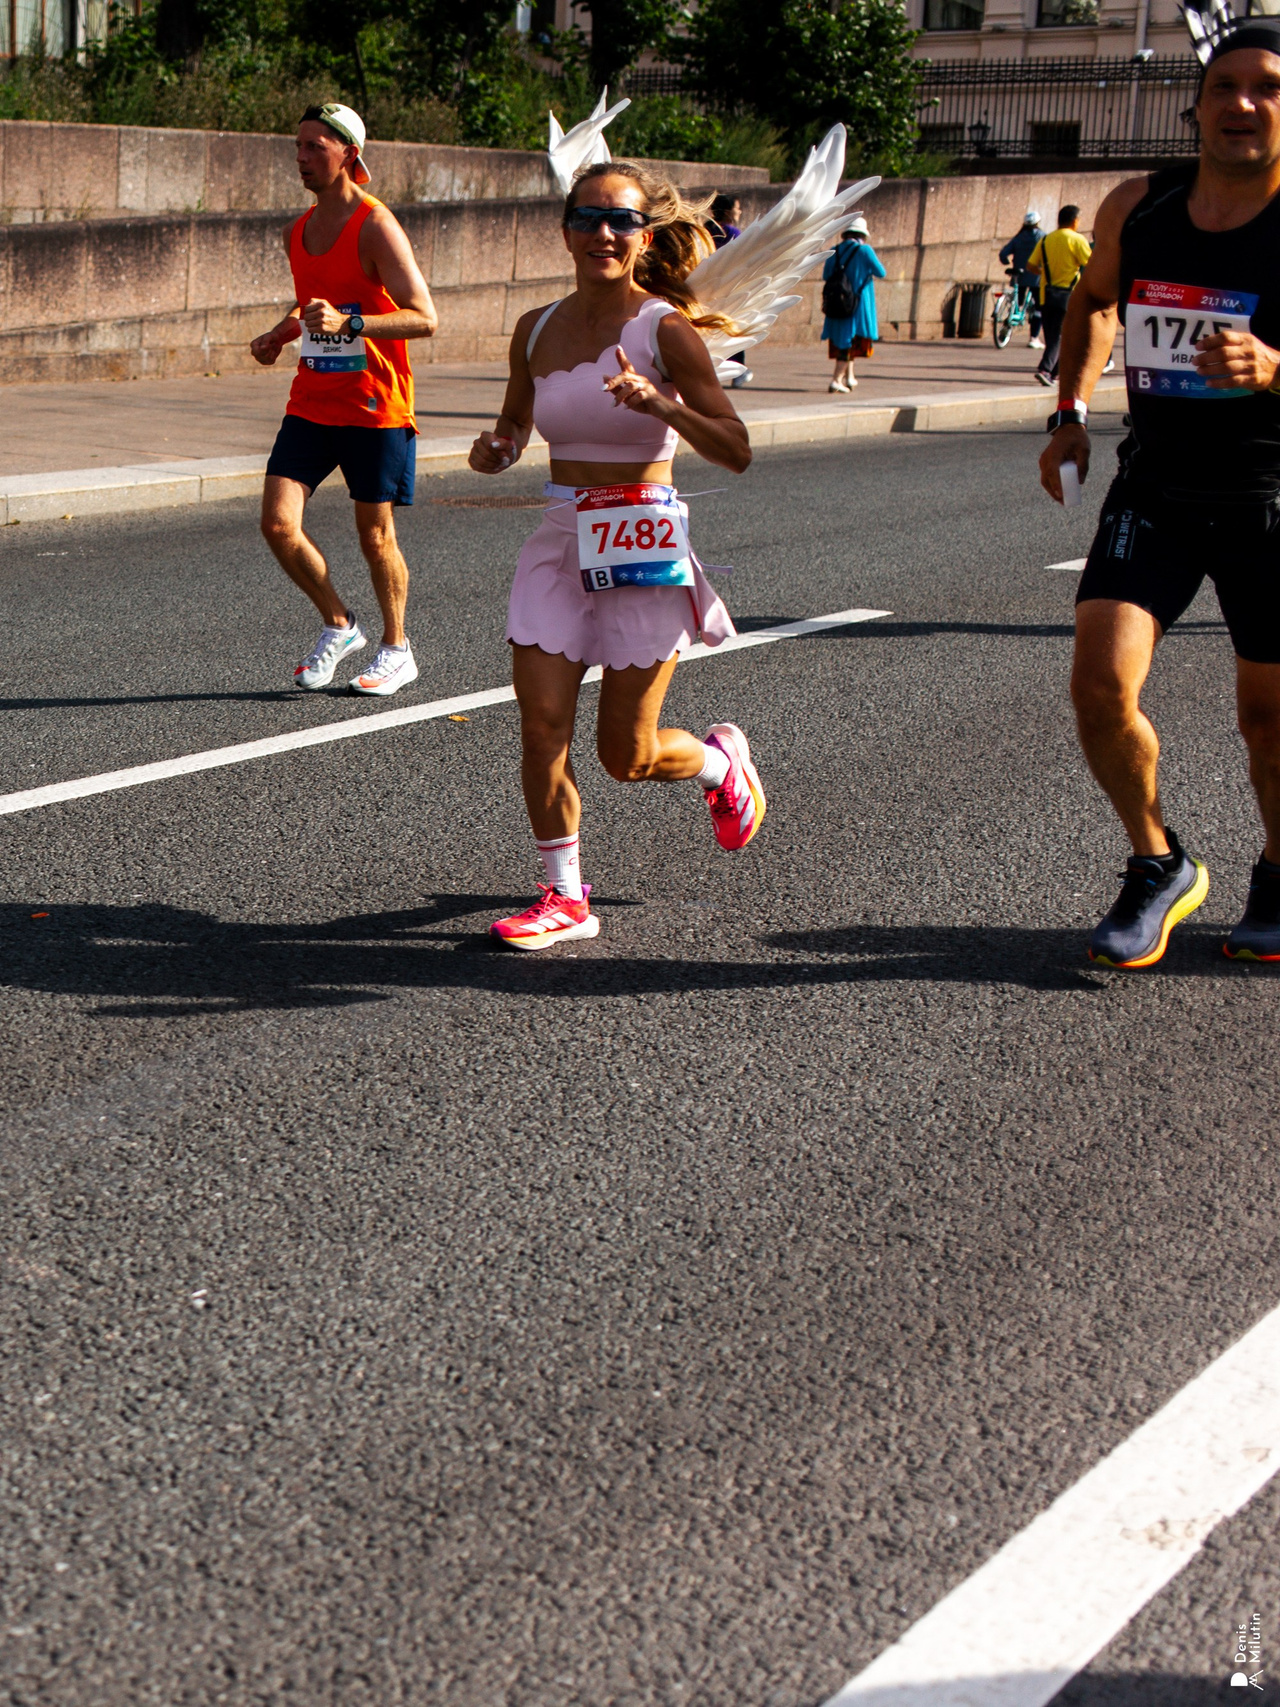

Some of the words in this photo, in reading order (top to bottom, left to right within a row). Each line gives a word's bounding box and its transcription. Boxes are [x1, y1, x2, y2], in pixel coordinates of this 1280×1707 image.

[1147, 284, 1168, 292] ПОЛУ
[1146, 291, 1183, 300] МАРАФОН
[1201, 296, 1219, 306] 21,1
[590, 493, 625, 503] МАРАФОН
[591, 518, 677, 555] 7482
[1114, 535, 1128, 559] TRUST
